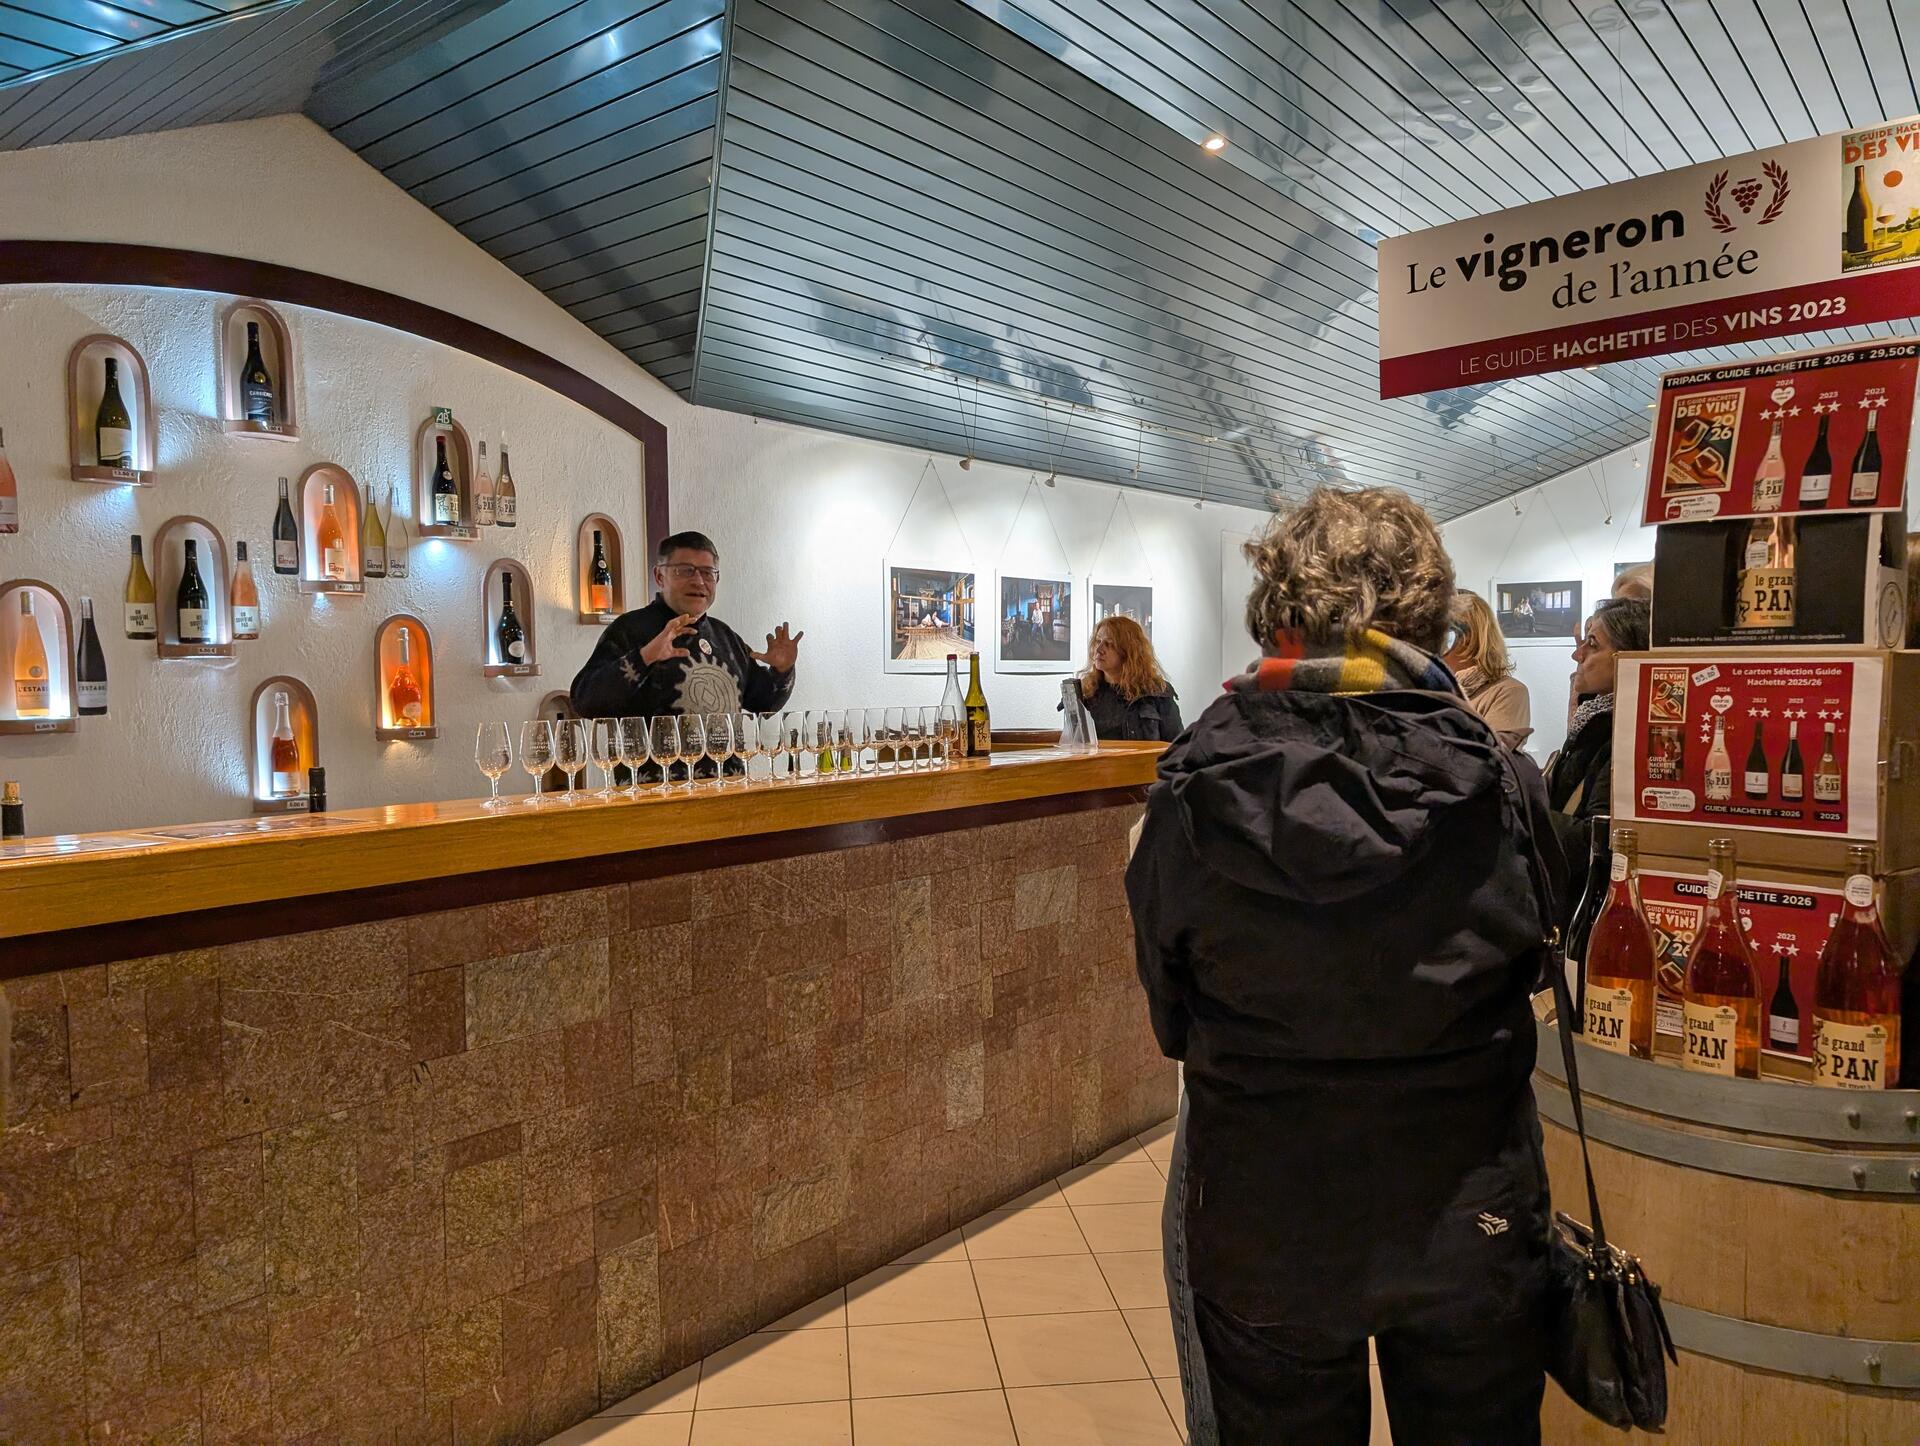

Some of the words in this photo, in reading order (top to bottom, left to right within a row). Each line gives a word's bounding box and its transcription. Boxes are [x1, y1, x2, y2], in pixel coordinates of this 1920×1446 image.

[1859, 127, 1893, 143] GUIDE
[1844, 138, 1888, 165] DES
[1407, 262, 1446, 294] Le
[1455, 208, 1685, 292] vigneron
[1552, 272, 1597, 309] de
[1609, 244, 1760, 300] l'année
[1460, 357, 1481, 376] LE
[1485, 346, 1547, 371] GUIDE
[1553, 325, 1667, 360] HACHETTE
[1673, 318, 1719, 340] DES
[1723, 305, 1784, 333] VINS
[1788, 296, 1848, 323] 2023
[1666, 372, 1711, 387] TRIPACK
[1716, 368, 1751, 380] GUIDE
[1755, 357, 1819, 376] HACHETTE
[1824, 352, 1855, 365] 2026
[1869, 345, 1916, 360] 29,50€
[1819, 391, 1838, 400] 2023
[1865, 387, 1885, 395] 2023
[1707, 394, 1738, 402] HACHETTE
[1677, 404, 1702, 419] DES
[1706, 399, 1738, 414] VINS
[436, 411, 450, 424] AB
[1711, 414, 1735, 427] 20
[1710, 426, 1733, 441] 26
[1755, 575, 1764, 586] le
[1768, 576, 1794, 588] gran
[1654, 673, 1668, 681] DES
[1669, 672, 1686, 680] VINS
[1732, 668, 1742, 676] Le
[1744, 668, 1771, 676] carton
[1773, 667, 1814, 676] Sélection
[1815, 667, 1842, 676] Guide
[1747, 678, 1786, 687] Hachette
[1787, 678, 1823, 687] 2025/26
[1672, 688, 1684, 696] 26
[1704, 805, 1727, 813] GUIDE
[1730, 806, 1772, 816] HACHETTE
[1820, 812, 1841, 820] 2025
[1677, 883, 1709, 895] GUIDE
[1782, 894, 1812, 906] 2026
[1667, 906, 1697, 917] HACHETTE
[1648, 913, 1662, 925] ES
[1665, 913, 1697, 929] VINS
[1672, 930, 1695, 943] 20
[1777, 932, 1796, 941] 2023
[1590, 999, 1612, 1012] grand
[1589, 1012, 1624, 1039] PAN
[1689, 1018, 1714, 1032] grand
[1689, 1032, 1728, 1060] PAN
[1821, 1034, 1829, 1046] le
[1831, 1038, 1865, 1052] grand
[1831, 1054, 1879, 1082] PAN
